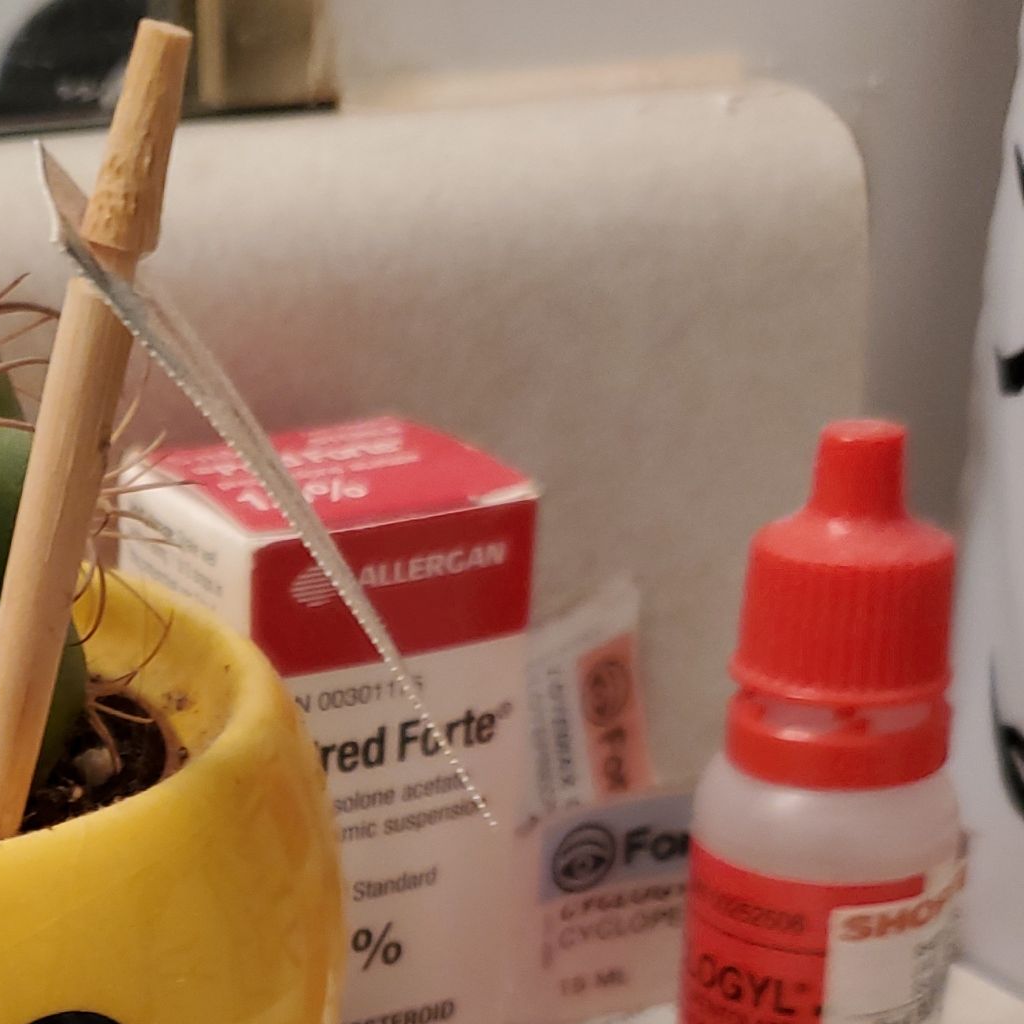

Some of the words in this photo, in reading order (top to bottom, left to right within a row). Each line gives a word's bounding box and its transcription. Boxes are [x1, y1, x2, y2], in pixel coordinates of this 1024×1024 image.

[359, 542, 508, 587] ALLERGAN
[317, 726, 386, 773] red
[334, 789, 396, 813] solone
[402, 772, 470, 802] acetat
[342, 822, 377, 842] mic
[352, 865, 439, 902] Standard
[351, 921, 403, 972] %
